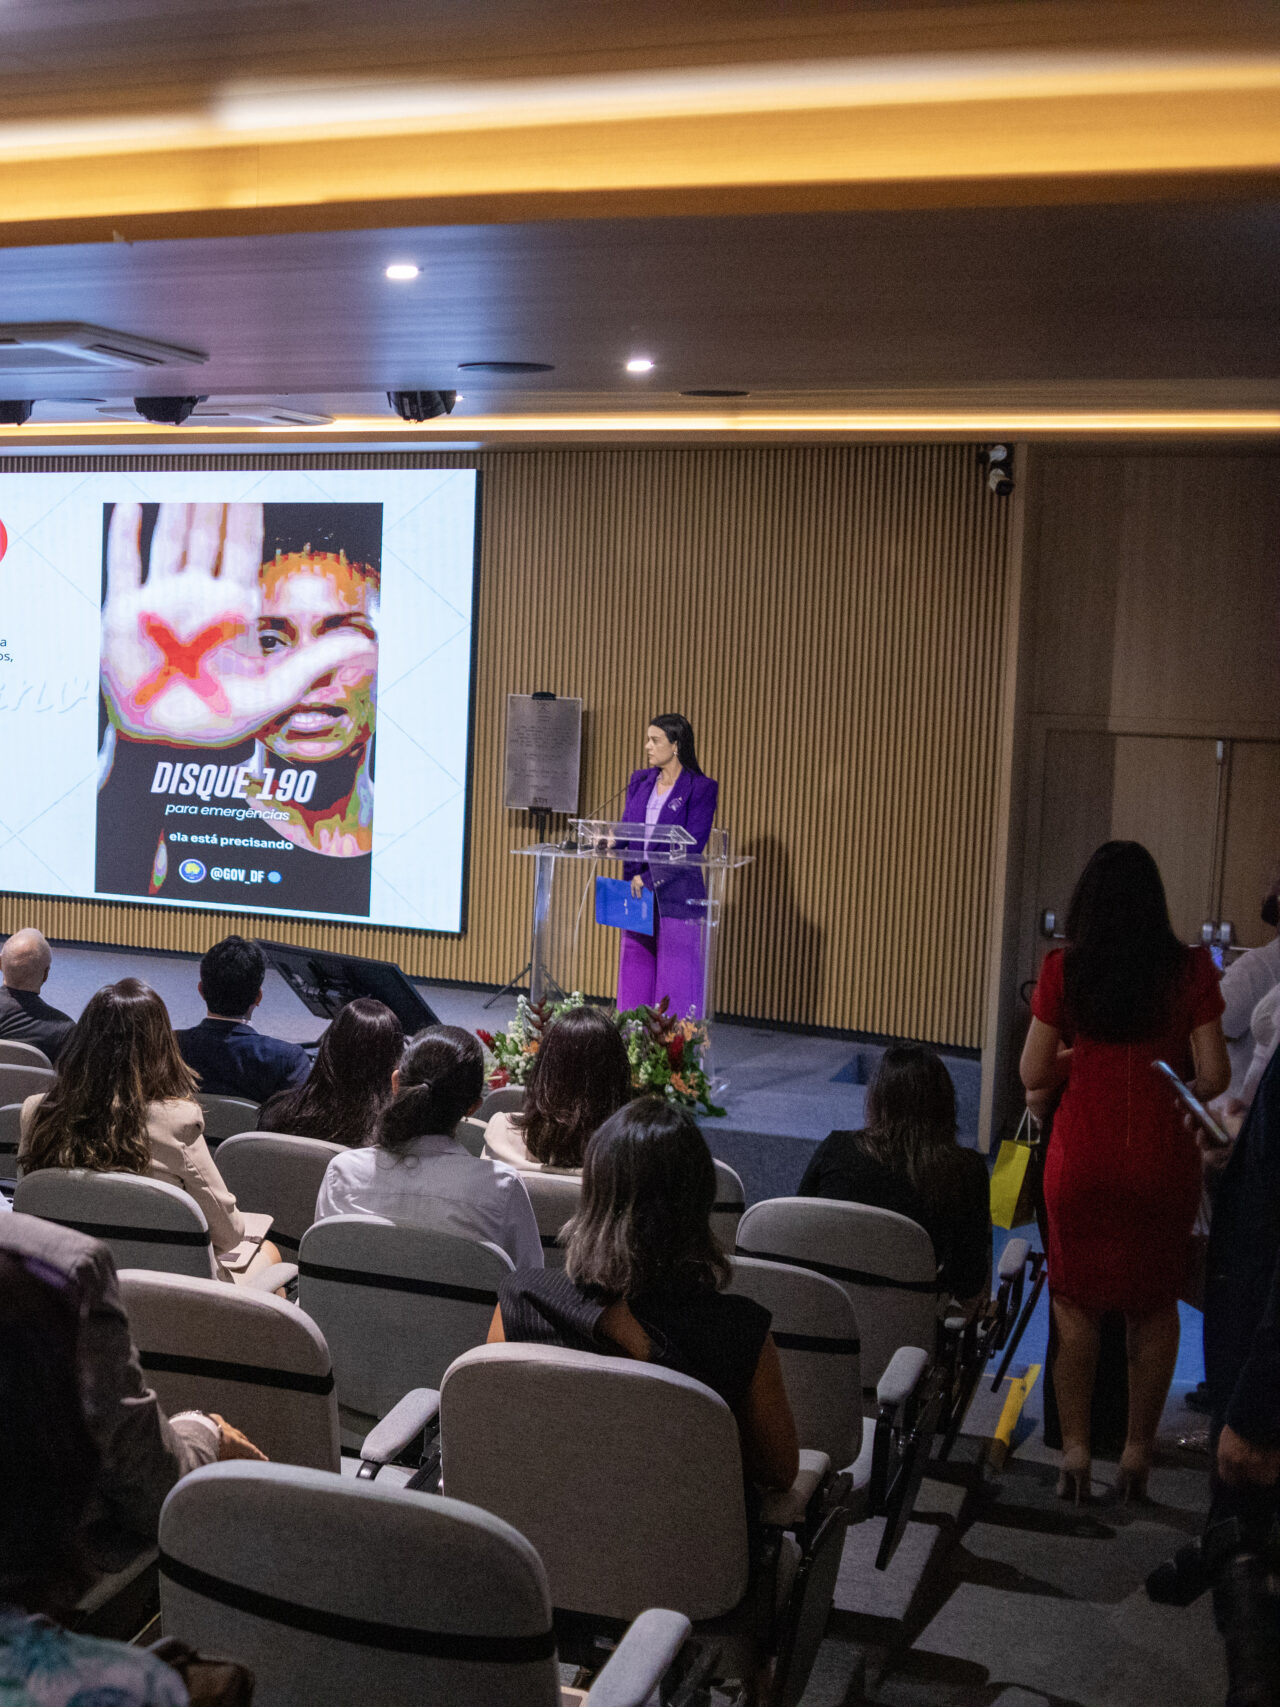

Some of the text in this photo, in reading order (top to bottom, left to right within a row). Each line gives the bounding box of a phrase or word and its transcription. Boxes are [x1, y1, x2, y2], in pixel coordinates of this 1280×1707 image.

[150, 761, 317, 803] DISQUE 190
[165, 803, 290, 821] para emergências
[169, 832, 294, 850] ela está precisando
[210, 867, 265, 885] @GOV_DF
